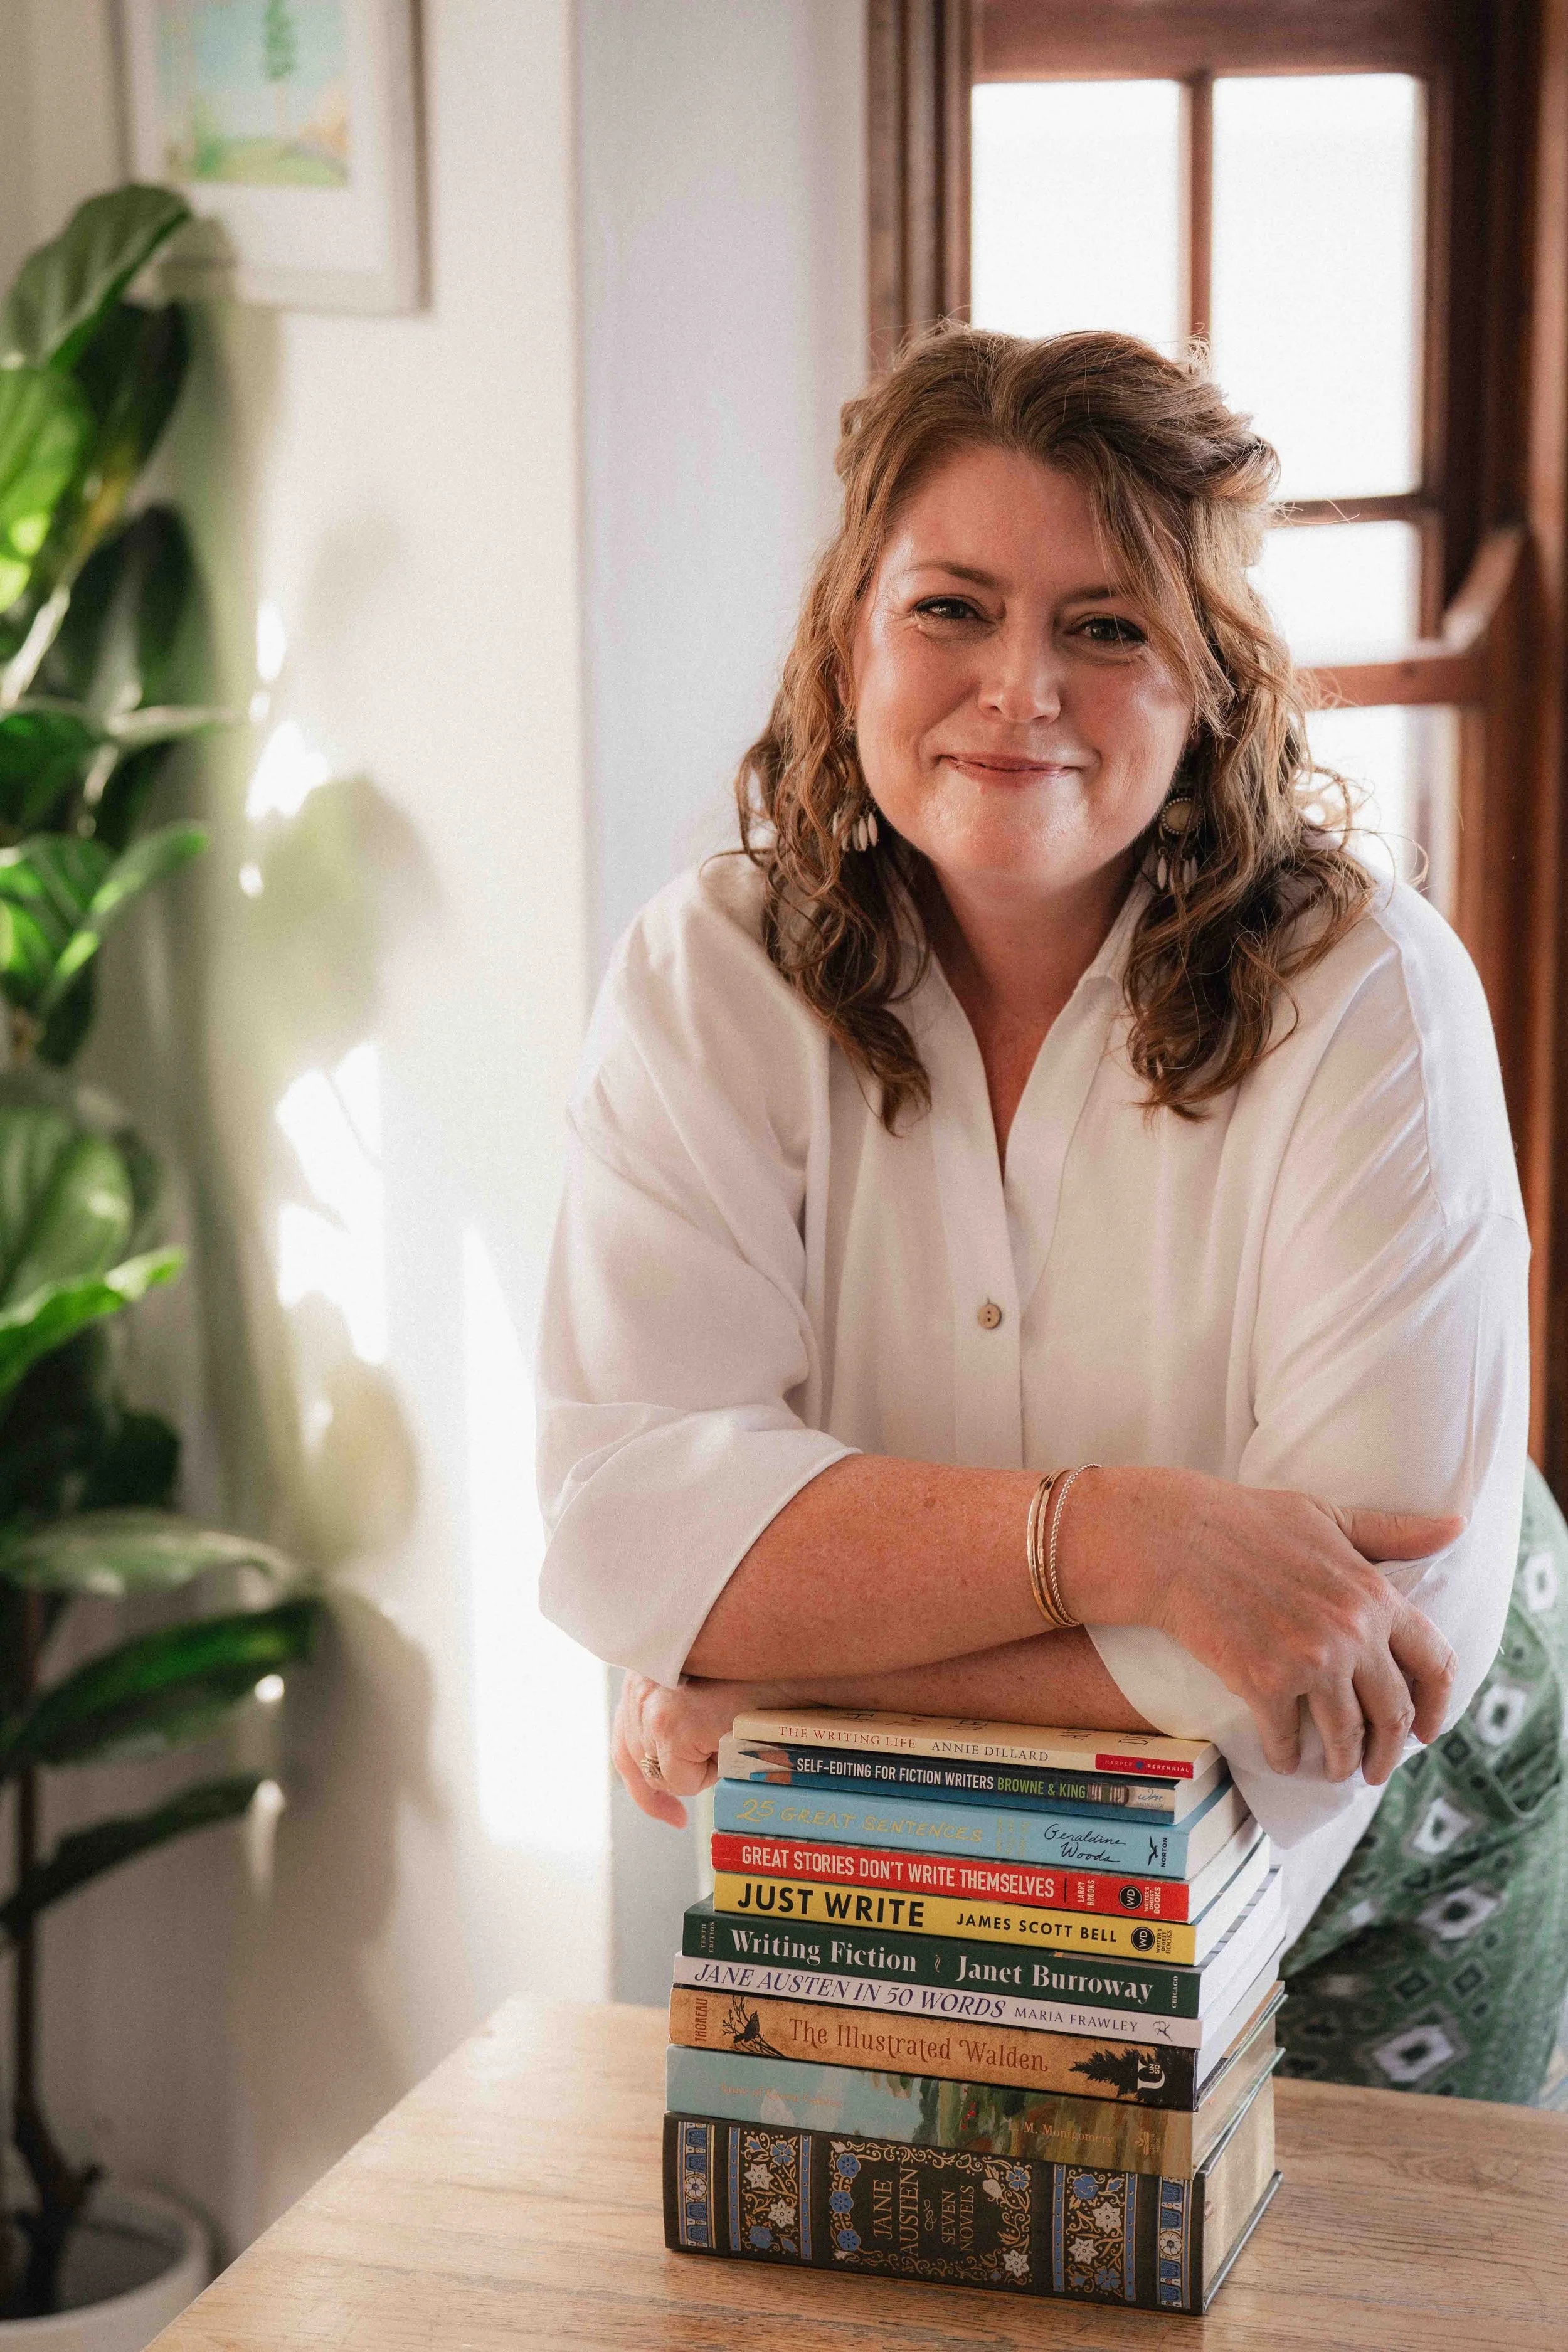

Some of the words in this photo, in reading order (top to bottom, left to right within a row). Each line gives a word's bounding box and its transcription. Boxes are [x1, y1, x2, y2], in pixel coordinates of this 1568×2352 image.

[779, 1725, 808, 1739] THE
[813, 1729, 880, 1745] WRITING
[886, 1737, 916, 1749] LIFE
[931, 1741, 979, 1755] ANNIE
[985, 1745, 1049, 1761] DILLARD
[797, 1757, 871, 1778] SELF-EDITING
[875, 1766, 896, 1781] FOR
[899, 1767, 941, 1785] FICTION
[945, 1771, 994, 1790] WRITERS
[997, 1777, 1044, 1795] BROWNE
[1047, 1783, 1056, 1796] &
[1059, 1783, 1086, 1799] KING
[1104, 1759, 1133, 1767] HARPER
[1147, 1763, 1189, 1772] PERENNIAL
[736, 1798, 775, 1823] 25
[780, 1806, 857, 1831] GREAT
[862, 1816, 983, 1843] SENTENCES
[1044, 1823, 1126, 1845] Geraldine
[741, 1845, 790, 1868] GREAT
[793, 1850, 855, 1875] STORIES
[859, 1858, 904, 1881] DON'T
[908, 1863, 955, 1887] WRITE
[959, 1868, 1054, 1899] THEMSELVES
[1060, 1842, 1121, 1863] Woods
[737, 1883, 814, 1915] JUST
[825, 1892, 925, 1928] WRITE
[1077, 1881, 1085, 1903] LARRY
[1087, 1879, 1095, 1906] BROOKS
[1126, 1888, 1135, 1907] WD
[956, 1913, 1012, 1931] JAMES
[1019, 1920, 1073, 1938] SCOTT
[1080, 1927, 1117, 1943] BELL
[1138, 1930, 1148, 1948] WD
[730, 1929, 821, 1966] Writing
[828, 1940, 917, 1973] Fiction
[955, 1955, 1023, 1984] Janet
[1032, 1964, 1154, 2005] Burroway
[694, 1963, 755, 1987] JANE
[756, 1971, 851, 1998] AUSTEN
[853, 1982, 881, 2003] IN
[882, 1986, 914, 2007] 50
[921, 1991, 1007, 2018] WORDS
[1015, 2006, 1064, 2024] MARIA
[1069, 2013, 1139, 2033] FRAWLEY
[694, 1998, 709, 2042] THOREAU
[789, 2018, 828, 2050] The
[836, 2023, 951, 2063] Illustrated
[958, 2038, 1049, 2073] Walden
[1024, 2121, 1038, 2134] M.
[1042, 2124, 1114, 2146] Montgomery
[872, 2179, 893, 2240] JANE
[899, 2163, 919, 2258] AUSTEN
[941, 2190, 956, 2245] SEVEN
[959, 2185, 974, 2252] NOVELS
